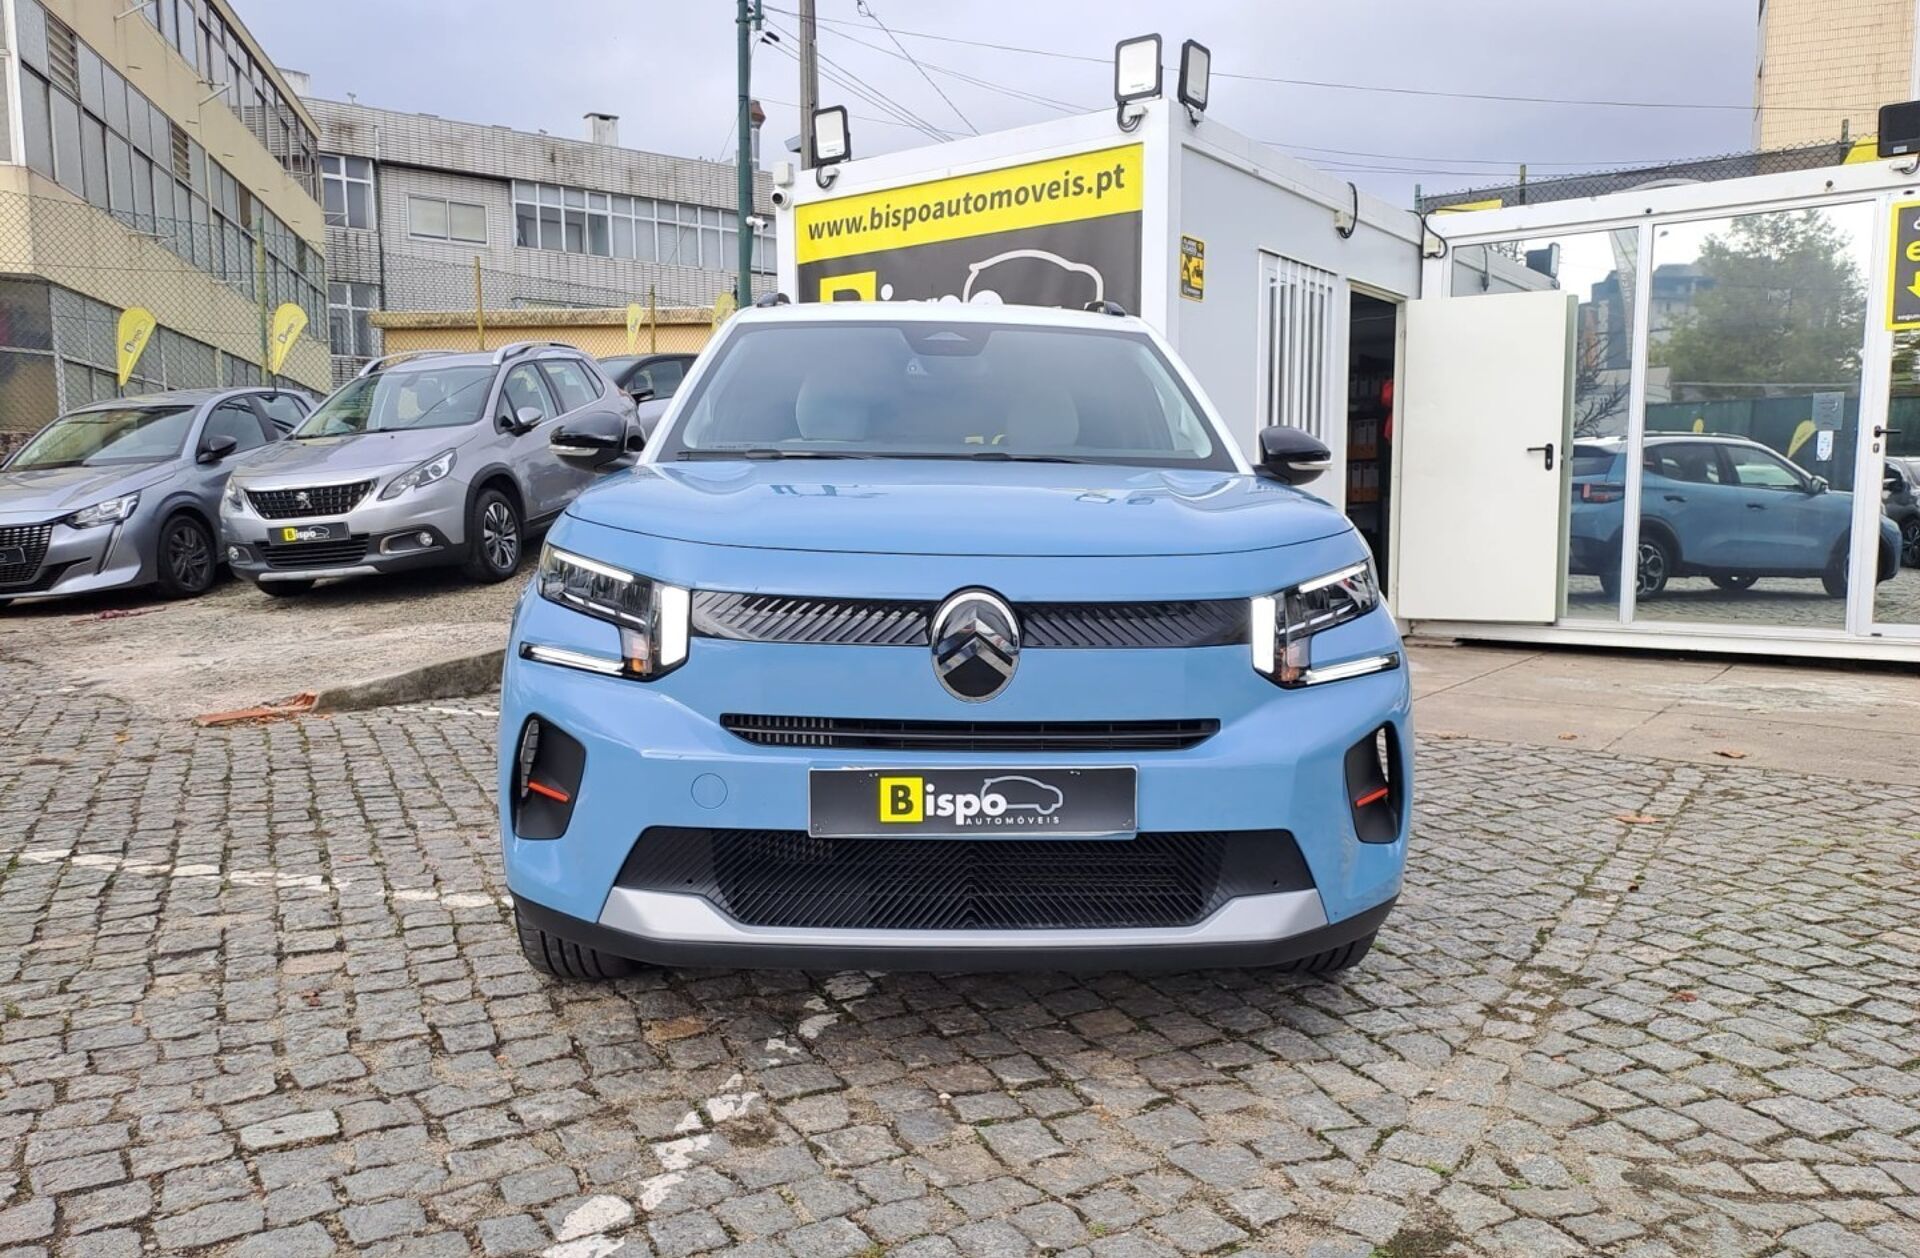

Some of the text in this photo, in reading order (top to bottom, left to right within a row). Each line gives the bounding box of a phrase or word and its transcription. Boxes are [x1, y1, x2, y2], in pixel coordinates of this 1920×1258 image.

[808, 164, 1125, 241] www.bispoautomoveis.pt
[889, 783, 1007, 825] Bispo
[965, 816, 1060, 825] AUTOMÓVEIS
